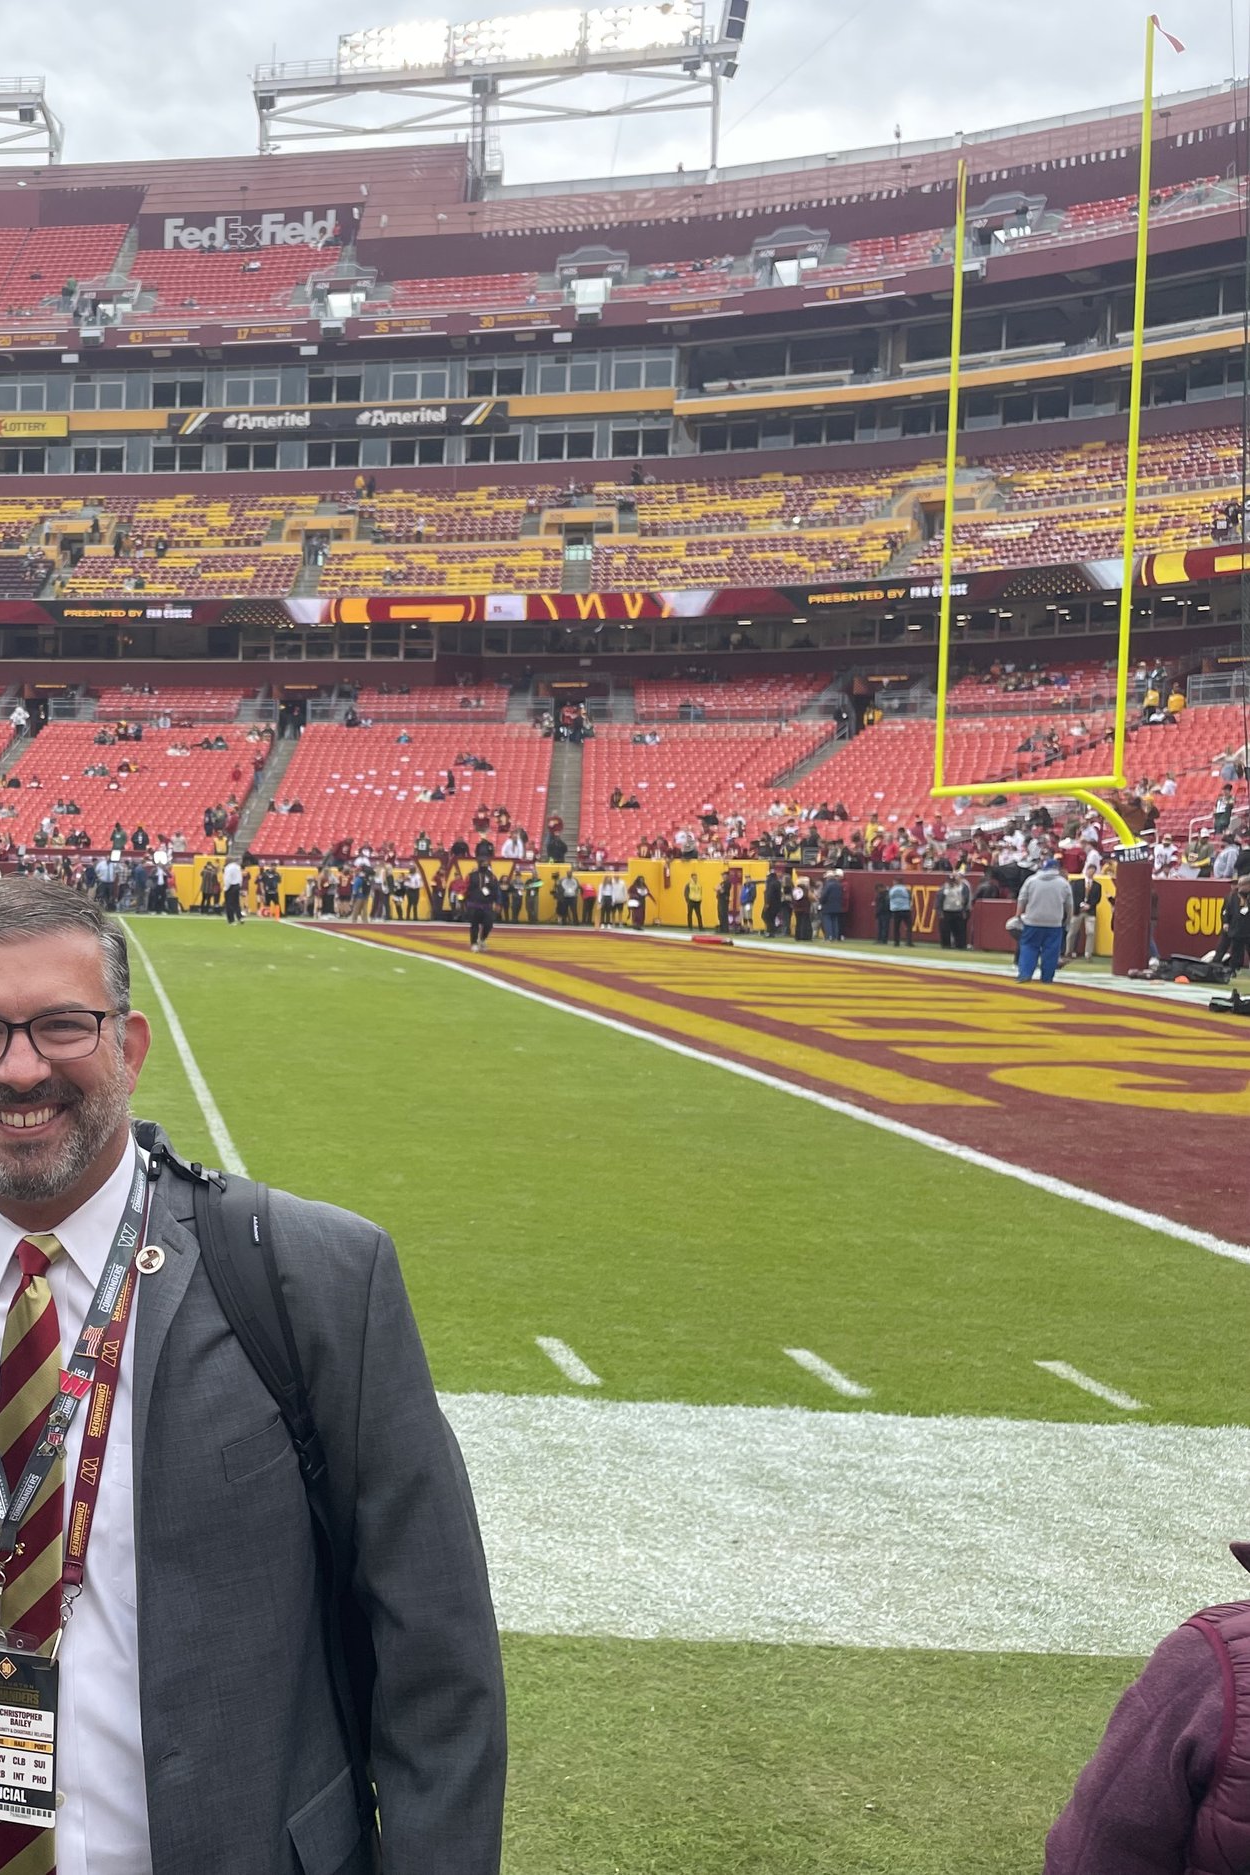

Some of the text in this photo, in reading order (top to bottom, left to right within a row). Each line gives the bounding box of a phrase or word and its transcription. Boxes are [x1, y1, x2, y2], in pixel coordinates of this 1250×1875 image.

[163, 209, 337, 250] FedExField
[374, 321, 389, 333] 35
[479, 316, 494, 328] 30
[237, 411, 311, 430] Ameritel
[370, 406, 447, 426] Ameritel
[4, 422, 46, 432] LOTTERY
[808, 589, 885, 605] PRESENTED
[886, 588, 906, 599] BY
[64, 609, 126, 618] PRESENTED
[128, 609, 143, 618] BY
[100, 1264, 124, 1313] COMMANDERS
[90, 1383, 108, 1438] COMMANDERS
[10, 1474, 40, 1521] COMMANDERS
[72, 1501, 86, 1558] COMMANDERS
[0, 1708, 43, 1722] CHRISTOPHER
[10, 1718, 32, 1728] BAILEY
[12, 1756, 26, 1766] CLB
[34, 1760, 46, 1770] SUI
[13, 1772, 24, 1781] INT
[32, 1775, 47, 1785] PHO
